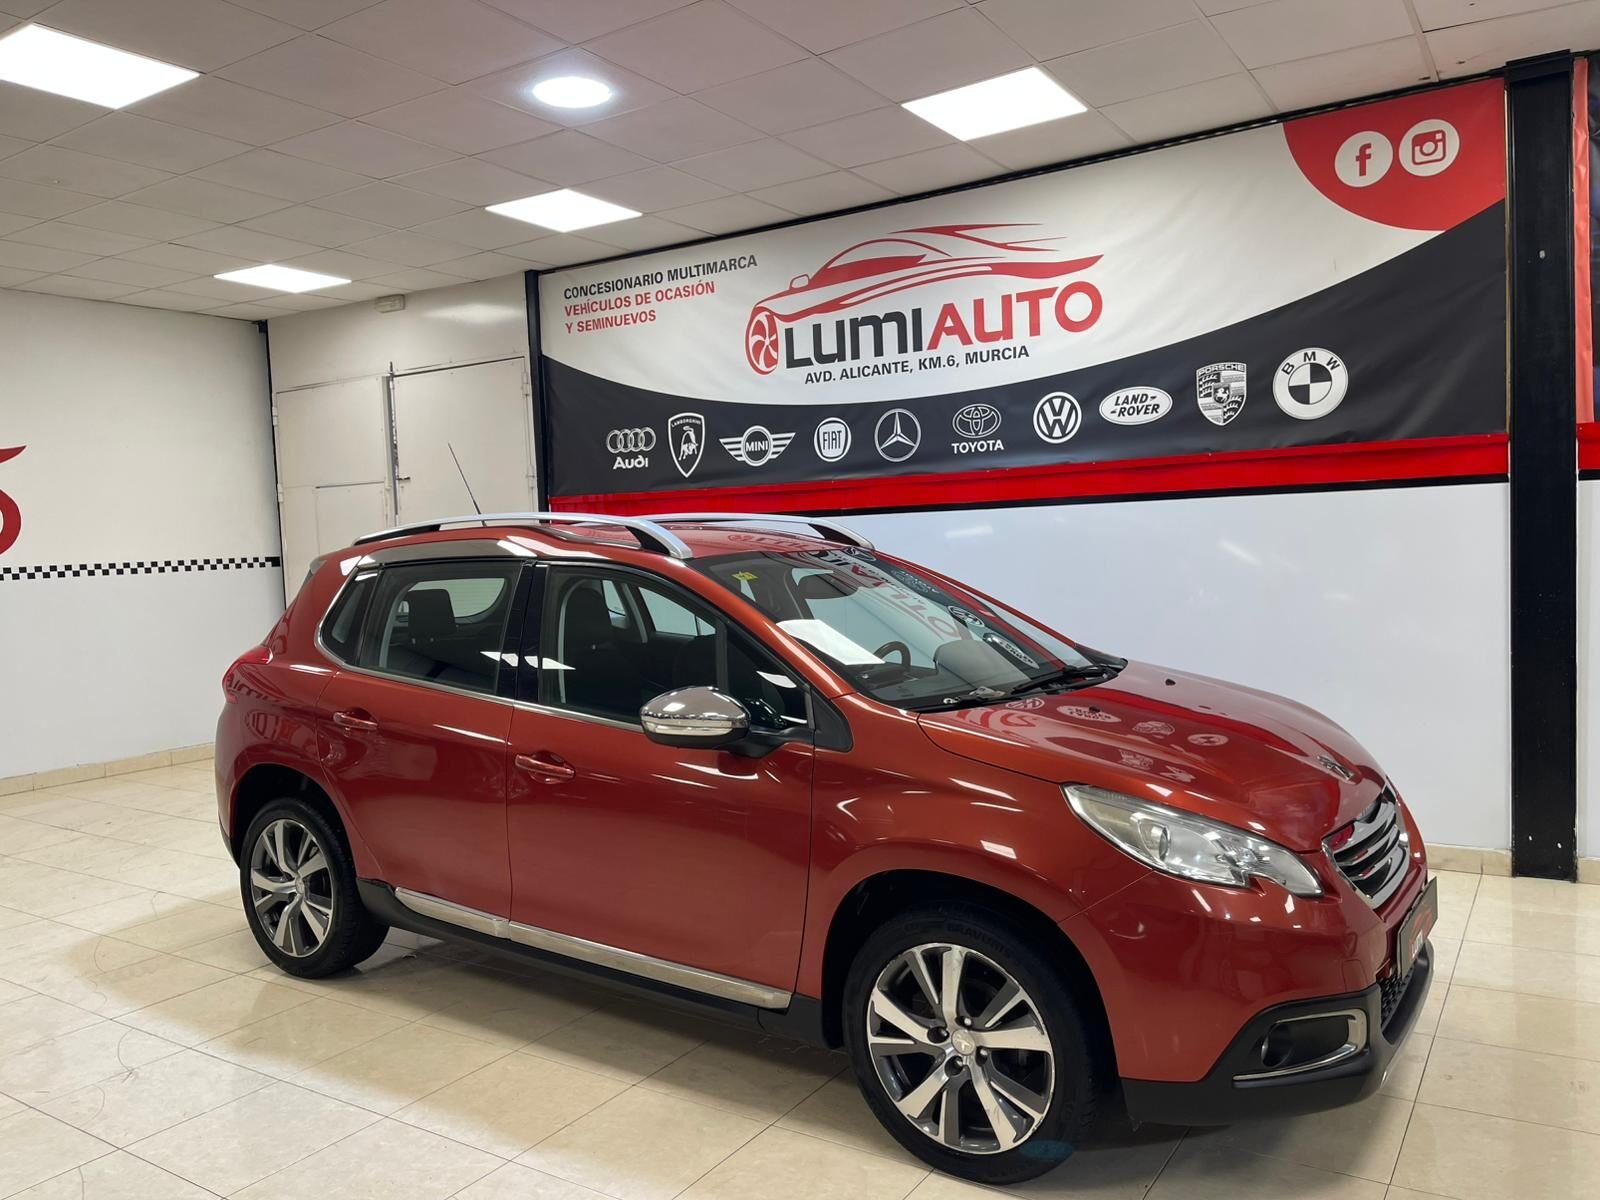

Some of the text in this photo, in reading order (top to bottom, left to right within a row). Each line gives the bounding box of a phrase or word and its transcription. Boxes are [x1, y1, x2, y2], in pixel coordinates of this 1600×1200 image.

[563, 254, 758, 300] CONCESIONARIO MULTIMARCA
[564, 280, 716, 317] VEHÍCULOS DE OCASIÓN
[565, 309, 657, 334] Y SEMINUEVOS
[804, 345, 1030, 385] AVD. ALICANTE, KM.6, MURCIA
[1198, 362, 1246, 375] PORSCHE
[1281, 351, 1341, 375] BMW
[745, 440, 769, 453] MINI
[822, 429, 843, 450] FIAT
[951, 439, 1004, 455] TOYOTA
[612, 455, 649, 470] Audi
